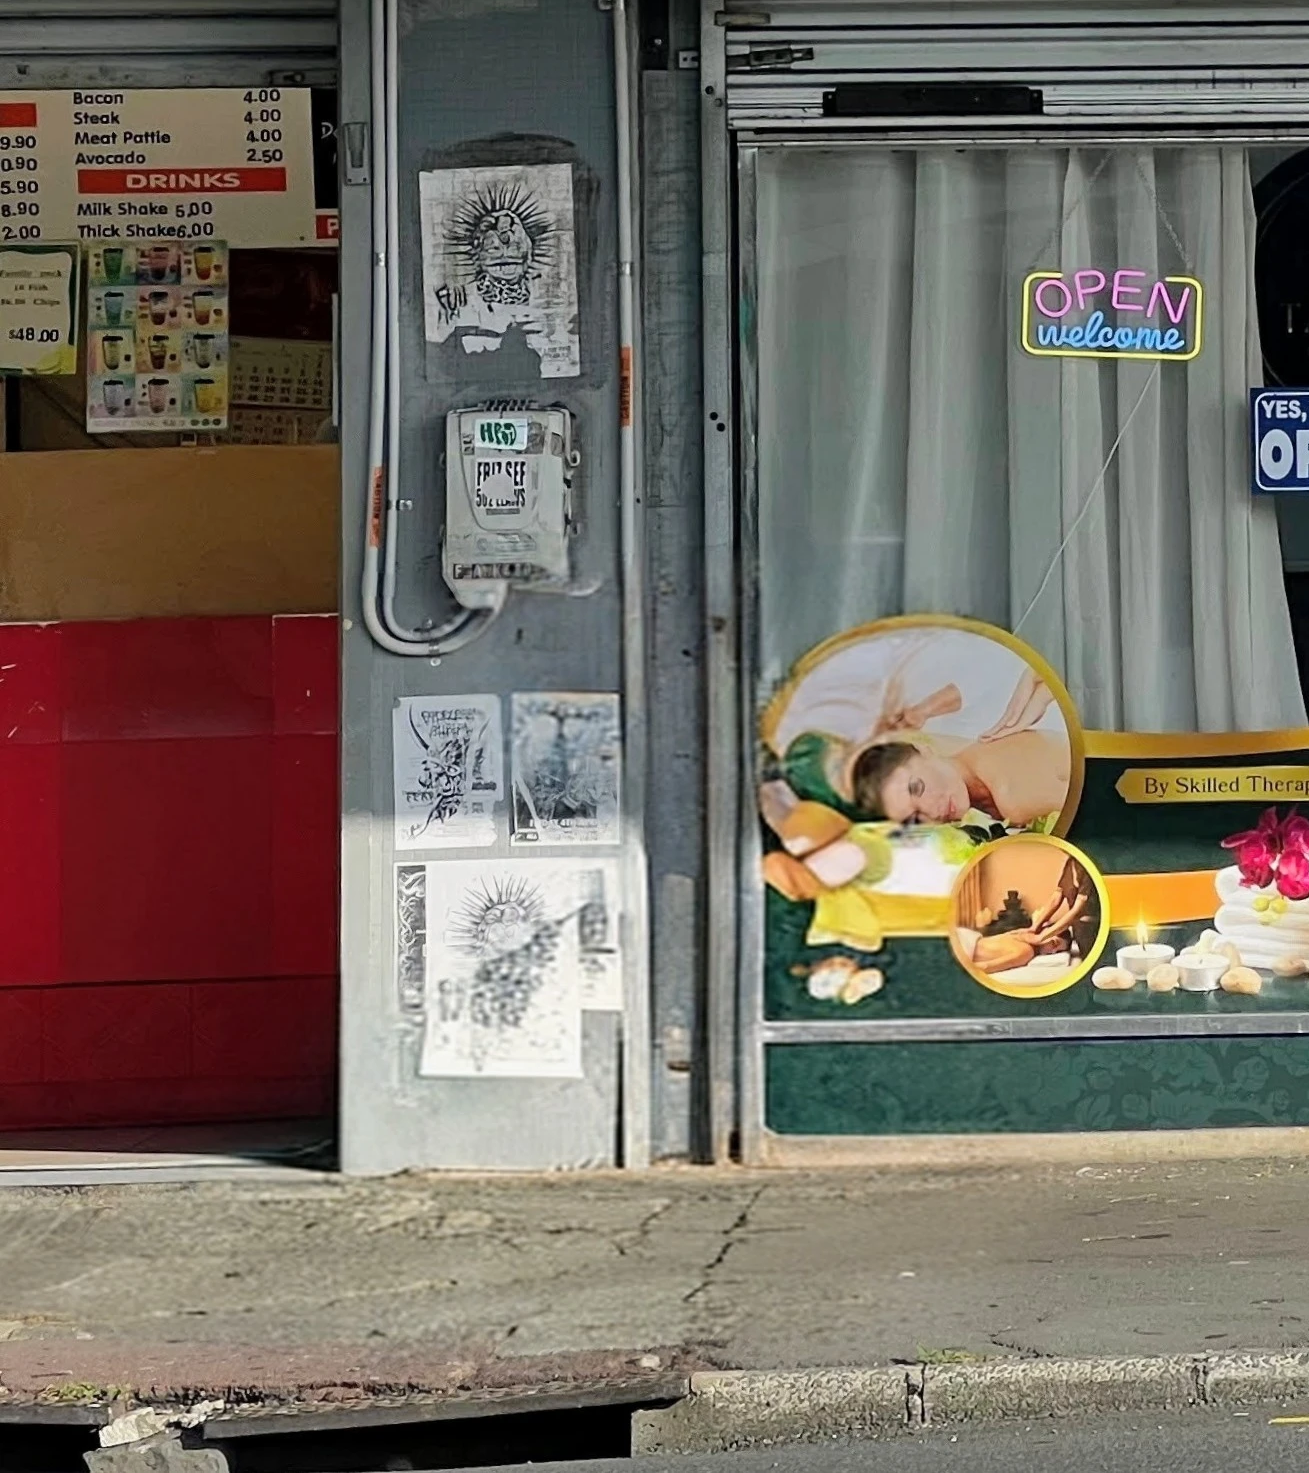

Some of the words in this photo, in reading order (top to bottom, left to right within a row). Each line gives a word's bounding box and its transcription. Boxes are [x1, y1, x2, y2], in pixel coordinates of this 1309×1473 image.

[73, 91, 124, 105] Bacon
[243, 89, 281, 103] 4.00
[73, 112, 120, 125] Steak
[244, 109, 282, 123] 4.00
[74, 132, 117, 145] Meat
[123, 131, 171, 145] Pattie
[246, 129, 282, 143] 4.00
[75, 152, 146, 165] Avocado
[246, 149, 283, 163] 2.50
[126, 172, 241, 189] DRINKS
[77, 202, 113, 217] Milk
[117, 202, 168, 217] Shake
[77, 224, 120, 239] Thick
[1035, 269, 1190, 324] OPEN
[1037, 309, 1185, 351] welcome
[1261, 399, 1308, 423] YES,
[1143, 776, 1169, 800] By
[1174, 773, 1241, 796] Skilled
